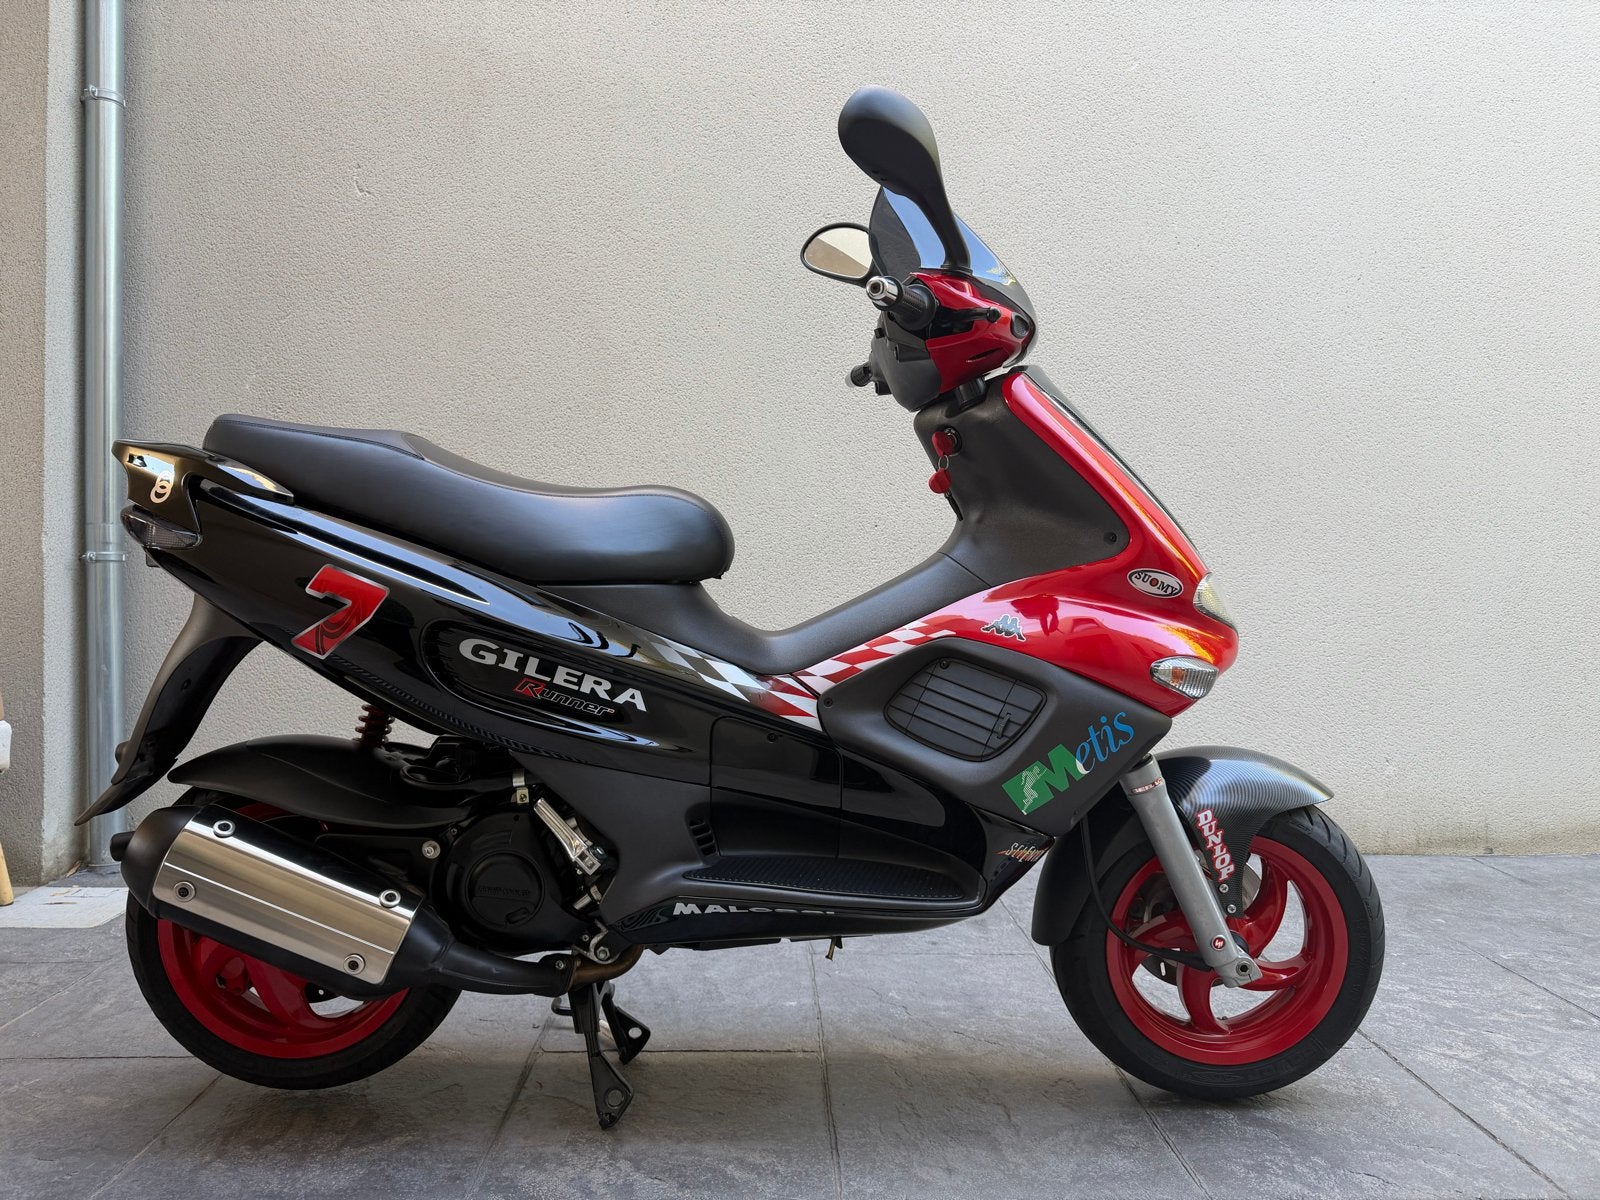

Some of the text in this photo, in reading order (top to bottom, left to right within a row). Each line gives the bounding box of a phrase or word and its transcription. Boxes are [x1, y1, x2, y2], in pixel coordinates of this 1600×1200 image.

[290, 564, 390, 660] 7
[1134, 571, 1178, 595] SUOMY
[459, 638, 647, 712] GILERA
[512, 677, 615, 716] Runner
[1001, 711, 1135, 815] Metis
[1197, 809, 1235, 881] DUNLOP
